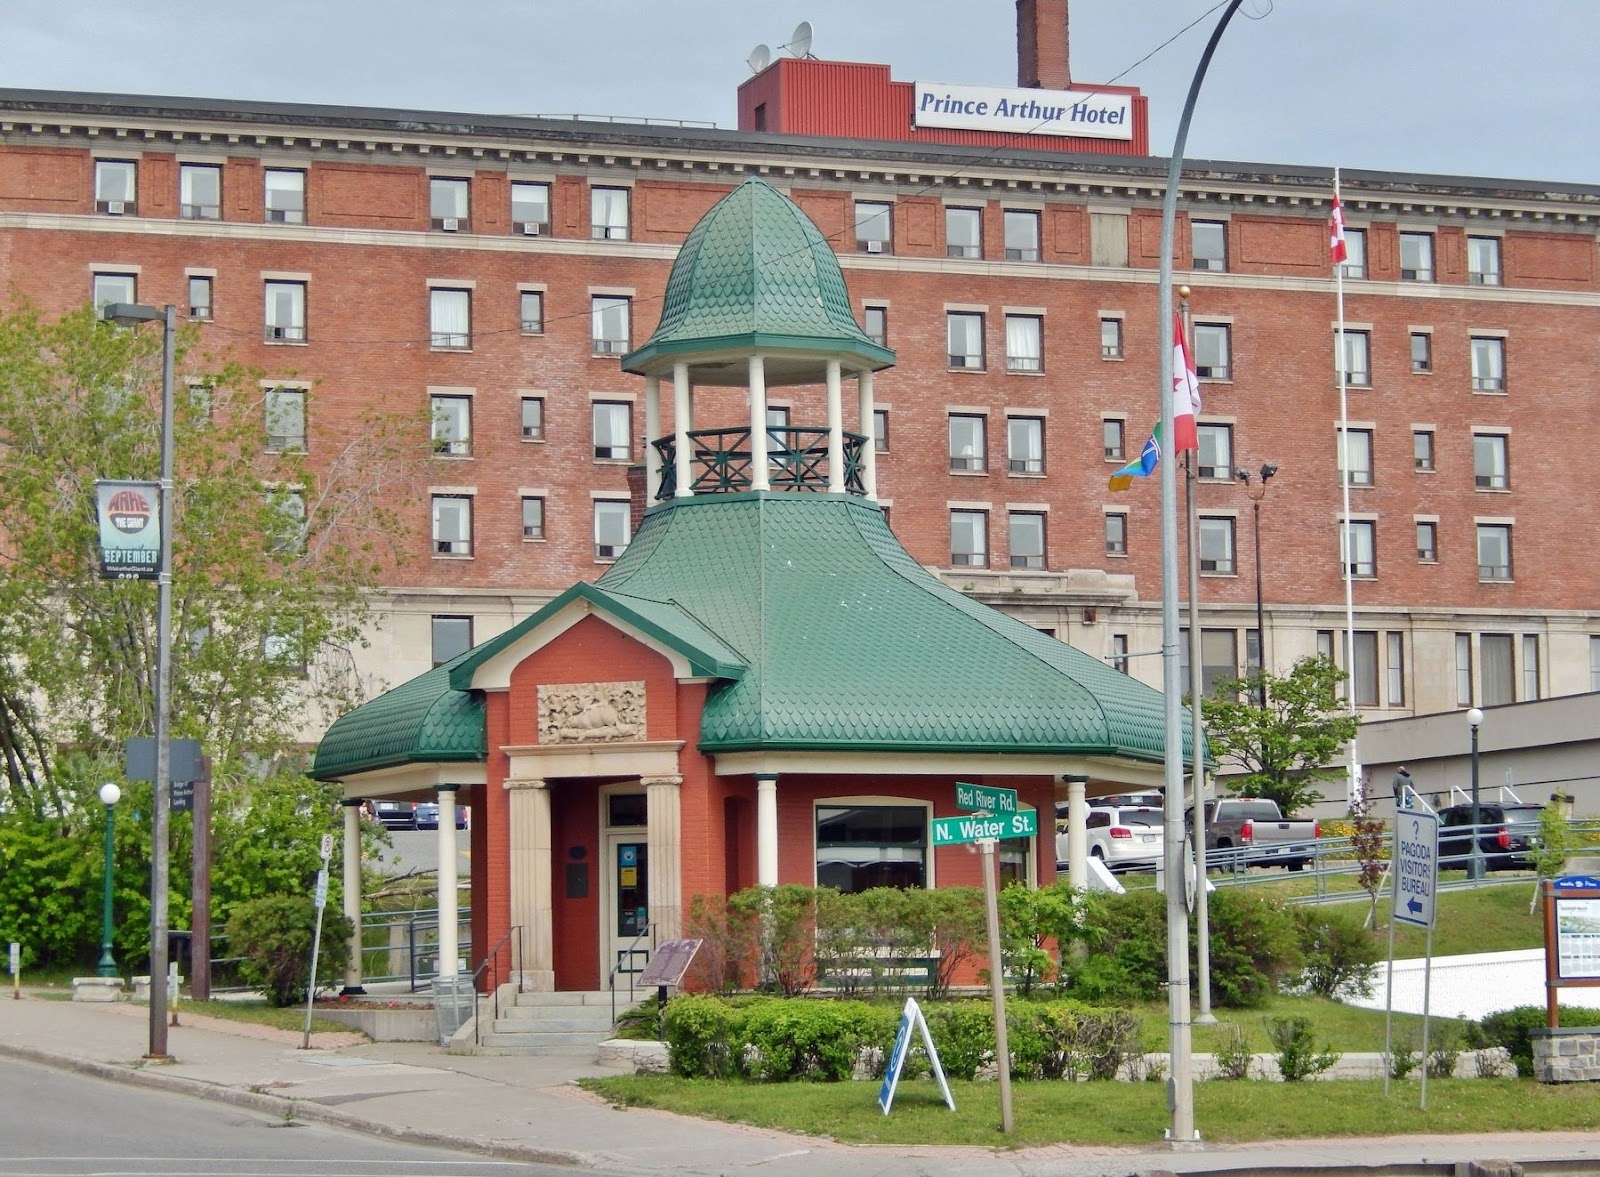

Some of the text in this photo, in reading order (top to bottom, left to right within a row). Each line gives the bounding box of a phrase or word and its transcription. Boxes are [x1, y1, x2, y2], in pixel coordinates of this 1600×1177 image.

[920, 93, 1126, 125] Prince Arthur Hotel
[109, 491, 149, 511] WAKE
[104, 550, 158, 564] SEPTEMBER
[958, 787, 1015, 812] Red River Rd.
[936, 815, 1033, 841] N. Water St.
[1401, 841, 1431, 860] PAGODA
[1401, 877, 1430, 897] BUREAU
